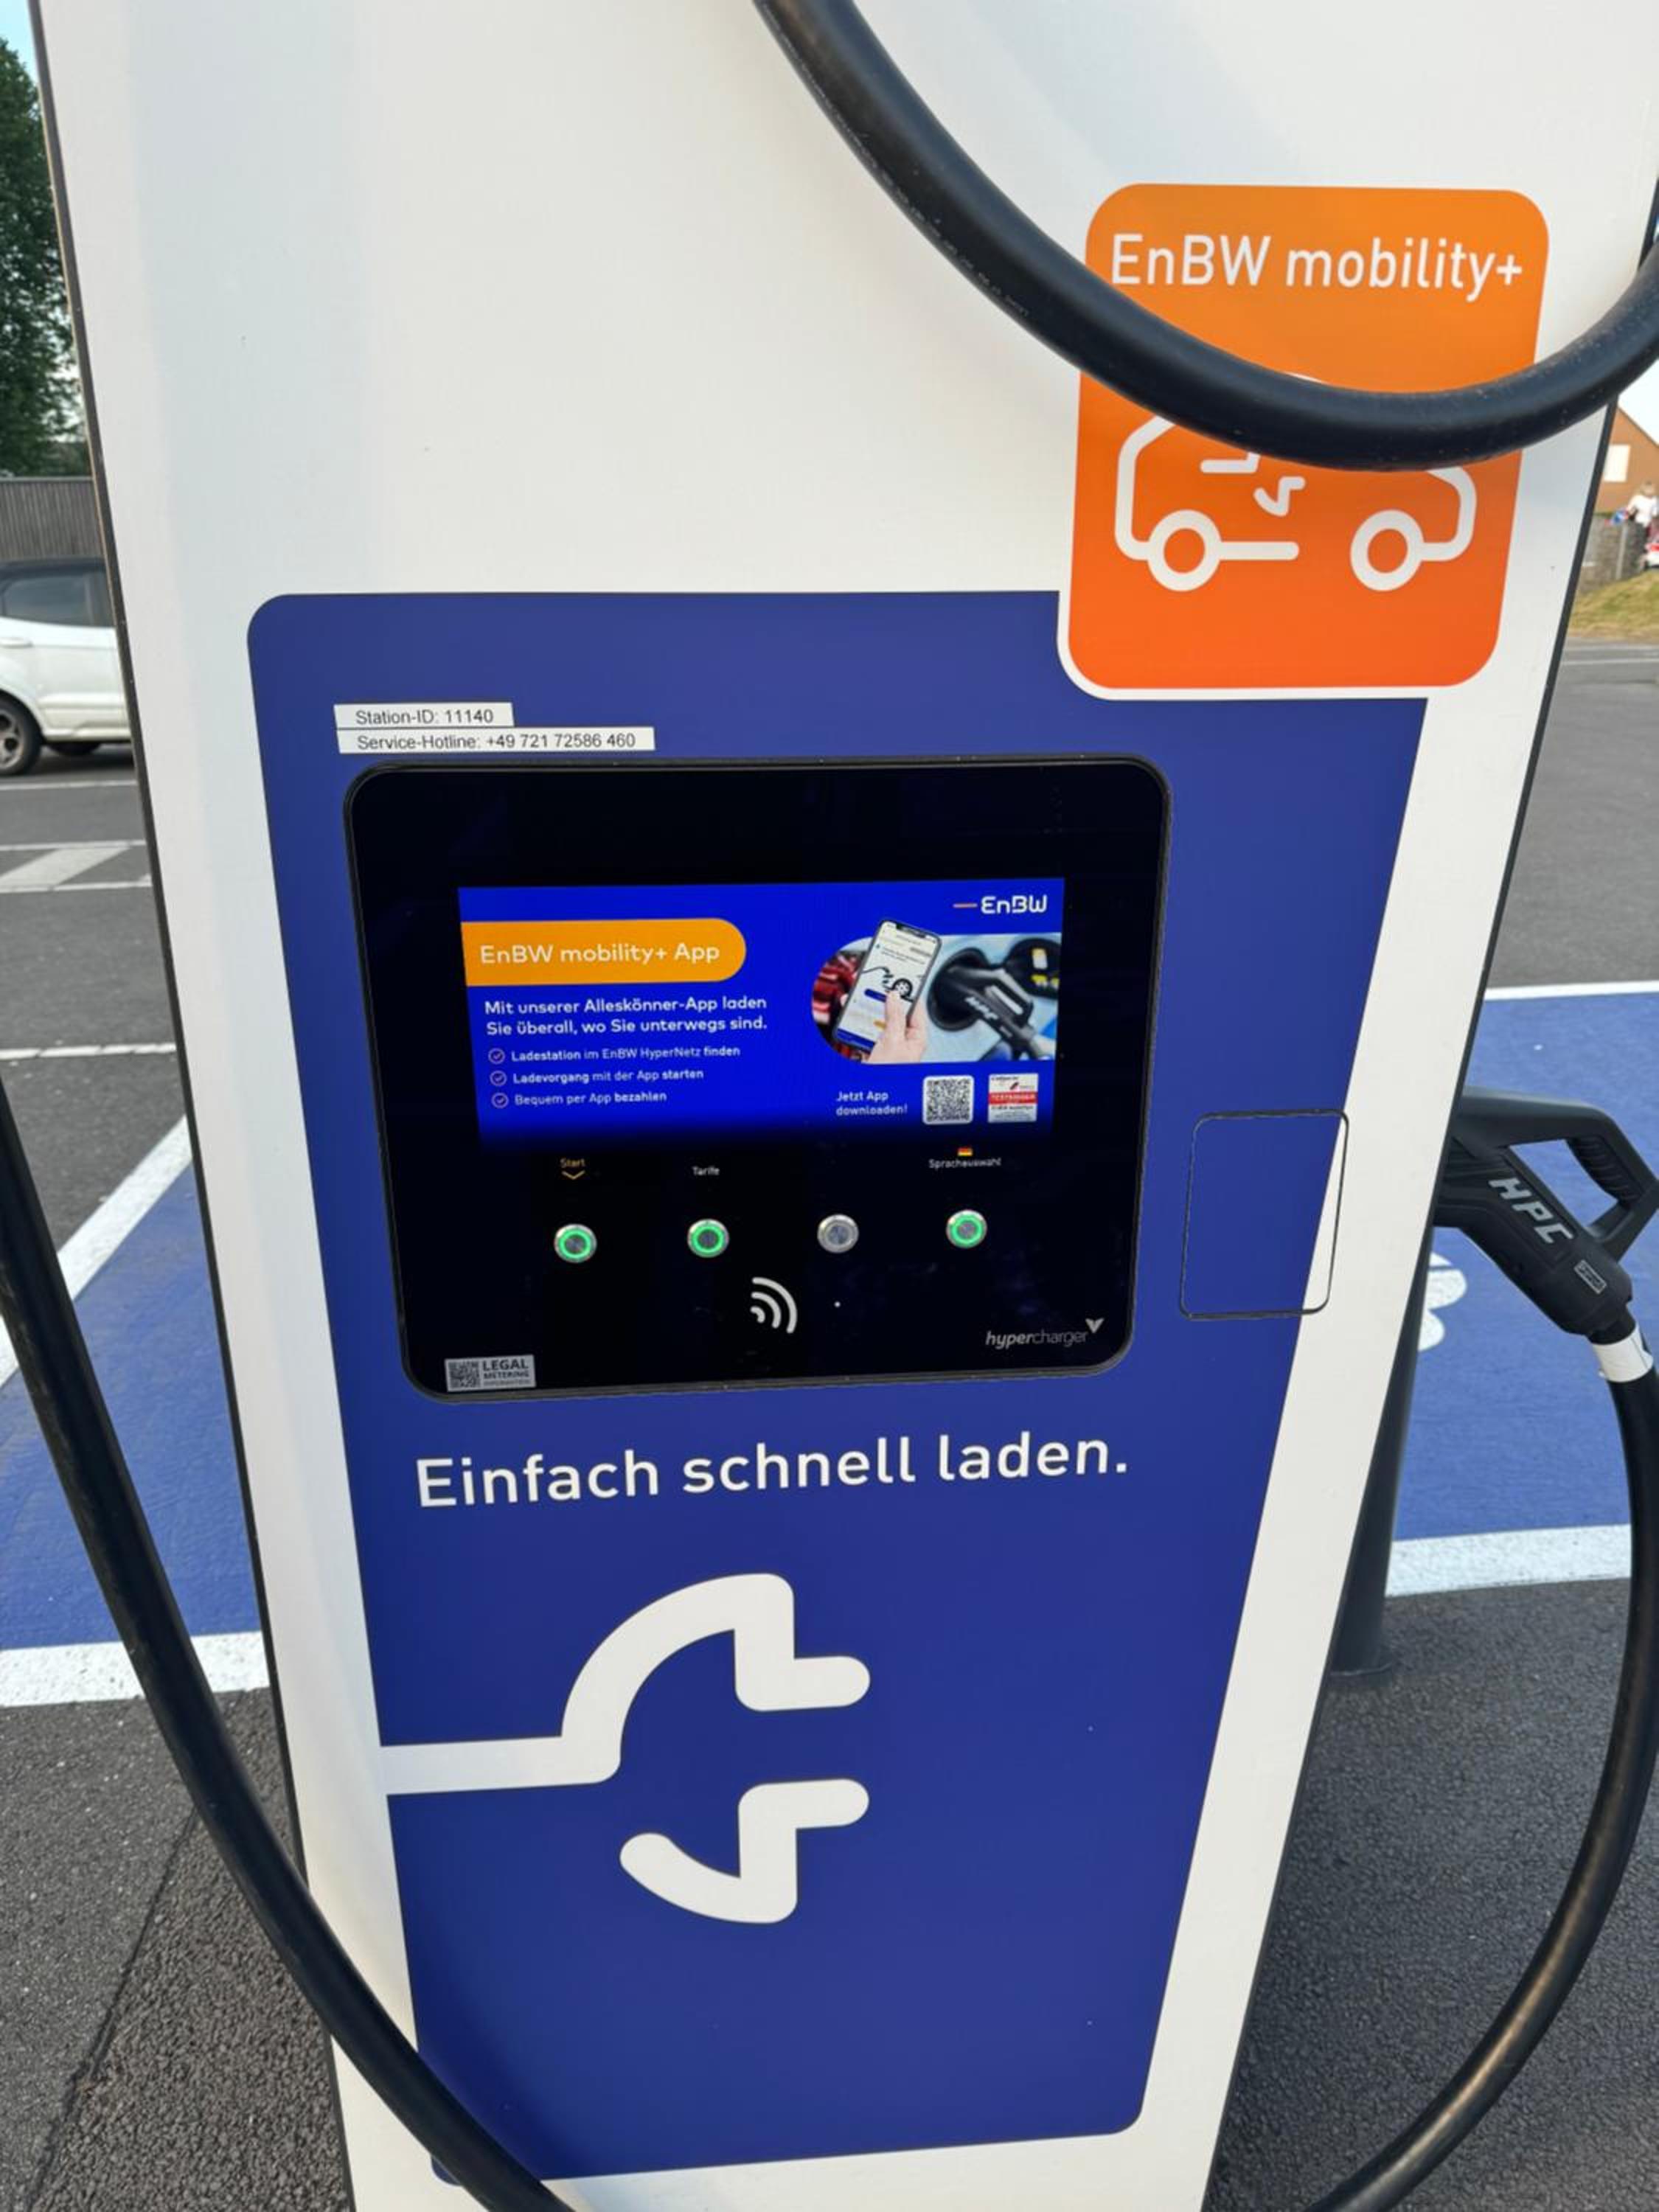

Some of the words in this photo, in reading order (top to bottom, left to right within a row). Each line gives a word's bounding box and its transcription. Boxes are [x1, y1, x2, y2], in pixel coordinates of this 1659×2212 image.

[1111, 234, 1271, 285] EnBW
[1286, 237, 1523, 302] mobility+
[355, 709, 439, 725] Station-ID:
[445, 709, 493, 723] 11140
[357, 734, 481, 750] Service-Hotline:
[486, 734, 515, 748] +49
[521, 734, 548, 748] 721
[554, 734, 602, 748] 72586
[607, 733, 636, 747] 460
[981, 894, 1047, 914] EnBW
[480, 945, 553, 964] EnBW
[560, 943, 668, 965] mobility+
[674, 942, 720, 964] App
[484, 1001, 513, 1015] Mit
[518, 1001, 580, 1014] unserer
[584, 995, 717, 1014] Alleskönner-App
[723, 995, 767, 1009] laden
[486, 1021, 512, 1035] Sie
[517, 1019, 578, 1036] überall,
[581, 1021, 606, 1033] wo
[611, 1018, 636, 1032] Sie
[640, 1018, 726, 1034] unterwegs
[729, 1016, 768, 1030] sind.
[511, 1049, 582, 1062] Ladestation
[583, 1049, 599, 1060] im
[602, 1048, 638, 1060] EnBW
[640, 1046, 701, 1060] HyperNetz
[703, 1046, 740, 1057] finden
[513, 1071, 589, 1085] Ladevorgang
[592, 1071, 611, 1082] mit
[614, 1069, 633, 1082] der
[636, 1068, 659, 1082] App
[661, 1068, 704, 1080] starten
[515, 1094, 564, 1106] Bequem
[566, 1095, 586, 1105] per
[589, 1092, 611, 1105] App
[614, 1091, 667, 1103] bezahlen
[836, 1091, 865, 1103] Jetzt
[867, 1091, 888, 1103] App
[835, 1105, 908, 1116] downloaden!
[560, 1158, 586, 1168] Start
[692, 1166, 720, 1176] Tarife
[928, 1157, 1002, 1169] Sprachauswahl
[1488, 1178, 1575, 1245] HPC
[985, 1329, 1088, 1349] hypercharger
[483, 1358, 529, 1371] LEGAL
[415, 1449, 659, 1508] Einfach
[682, 1436, 916, 1495] schnell
[938, 1431, 1129, 1482] laden.
